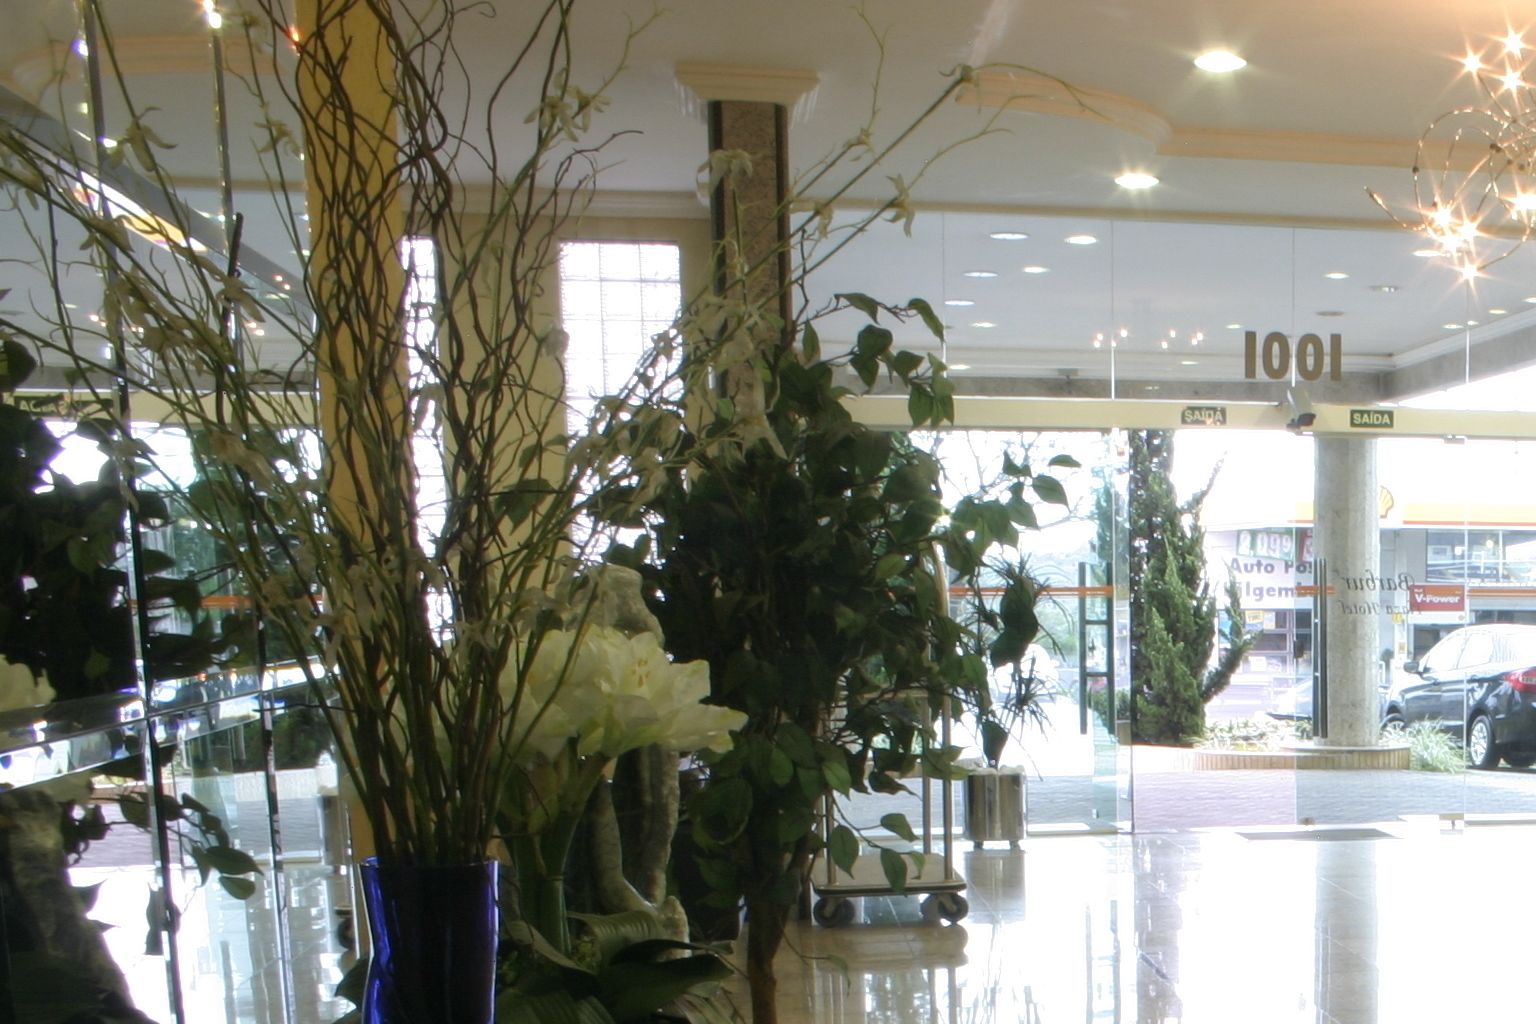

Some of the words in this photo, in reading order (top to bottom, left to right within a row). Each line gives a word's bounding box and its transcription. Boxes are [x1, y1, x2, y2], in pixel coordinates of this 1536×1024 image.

[1244, 331, 1342, 381] 1001
[1184, 408, 1224, 423] SAÍDA
[1353, 411, 1391, 425] SAÍDA
[1231, 558, 1275, 574] Auto
[1415, 593, 1461, 603] V-Power
